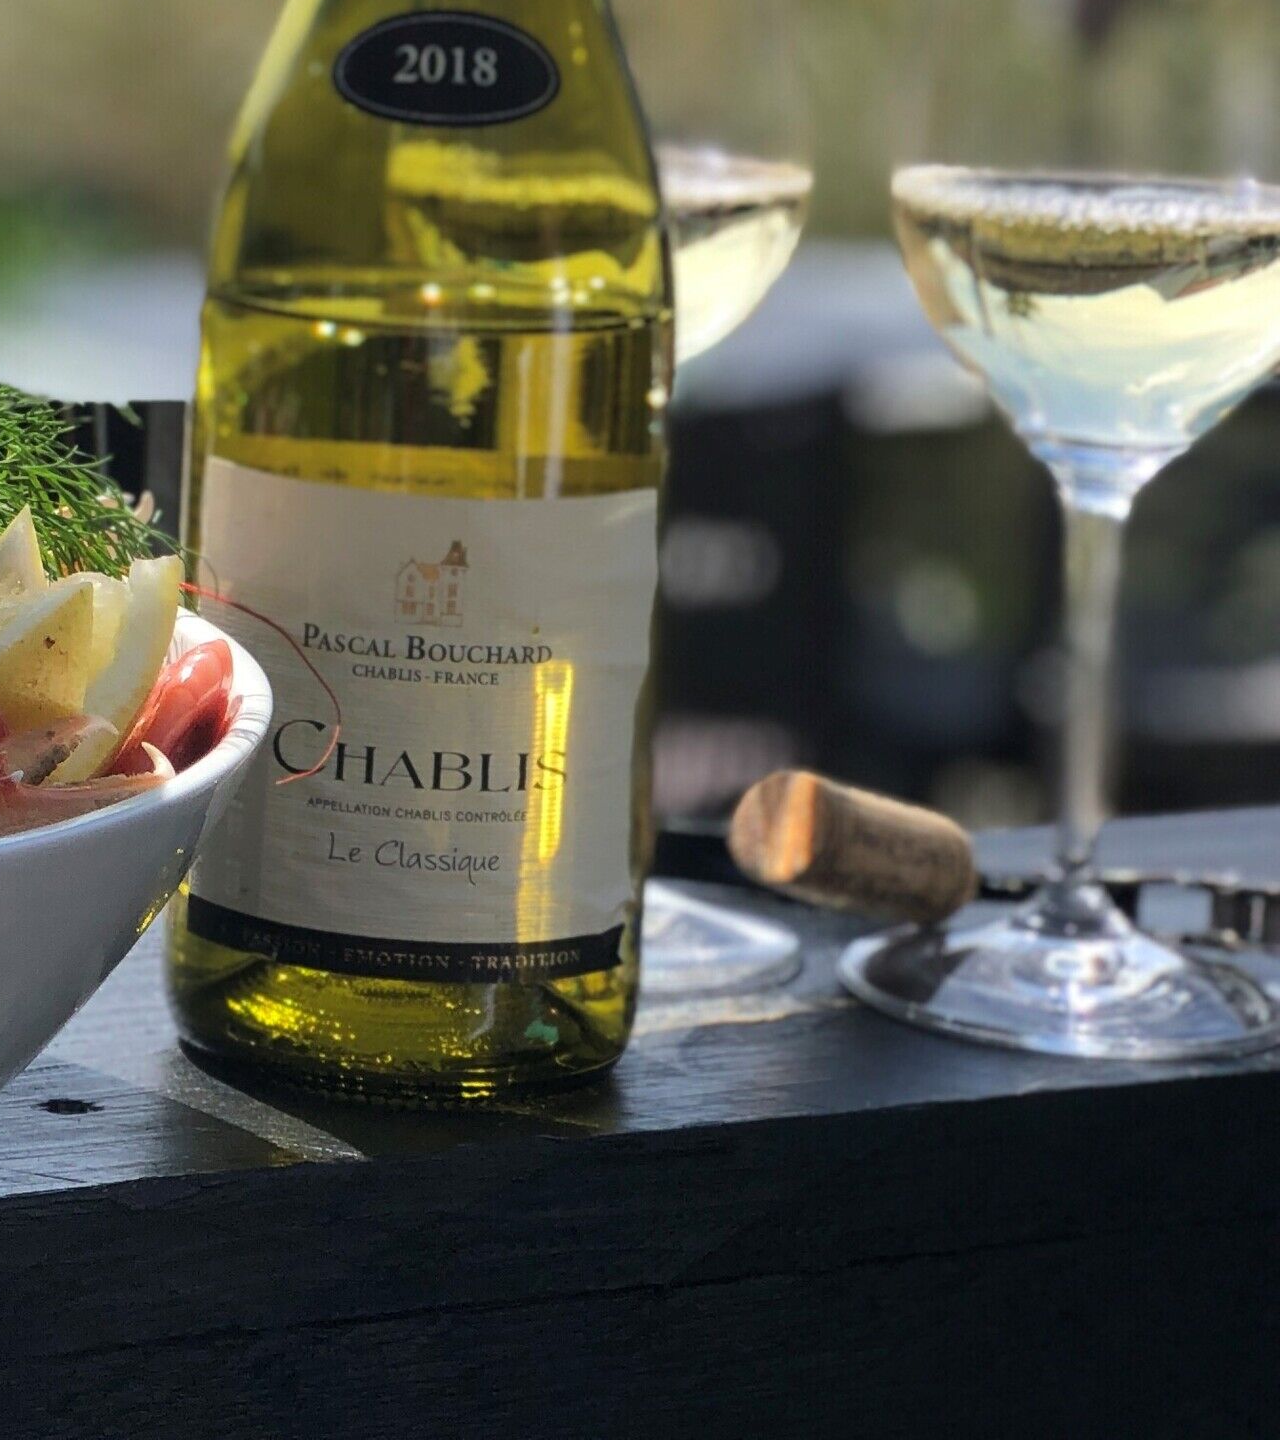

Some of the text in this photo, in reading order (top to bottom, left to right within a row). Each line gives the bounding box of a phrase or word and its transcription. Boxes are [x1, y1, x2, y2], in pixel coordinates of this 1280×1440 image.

[393, 44, 498, 87] 2018
[303, 622, 553, 664] PASCAL BOUCHARD
[351, 663, 422, 683] CHABLIS
[434, 671, 500, 686] FRANCE
[273, 719, 567, 793] CHABLIS
[306, 797, 391, 818] APPELLATION
[394, 808, 451, 822] CHABLIS
[327, 831, 501, 887] Le Classique
[343, 947, 450, 969] EMOTION
[471, 948, 580, 971] TRADITION
